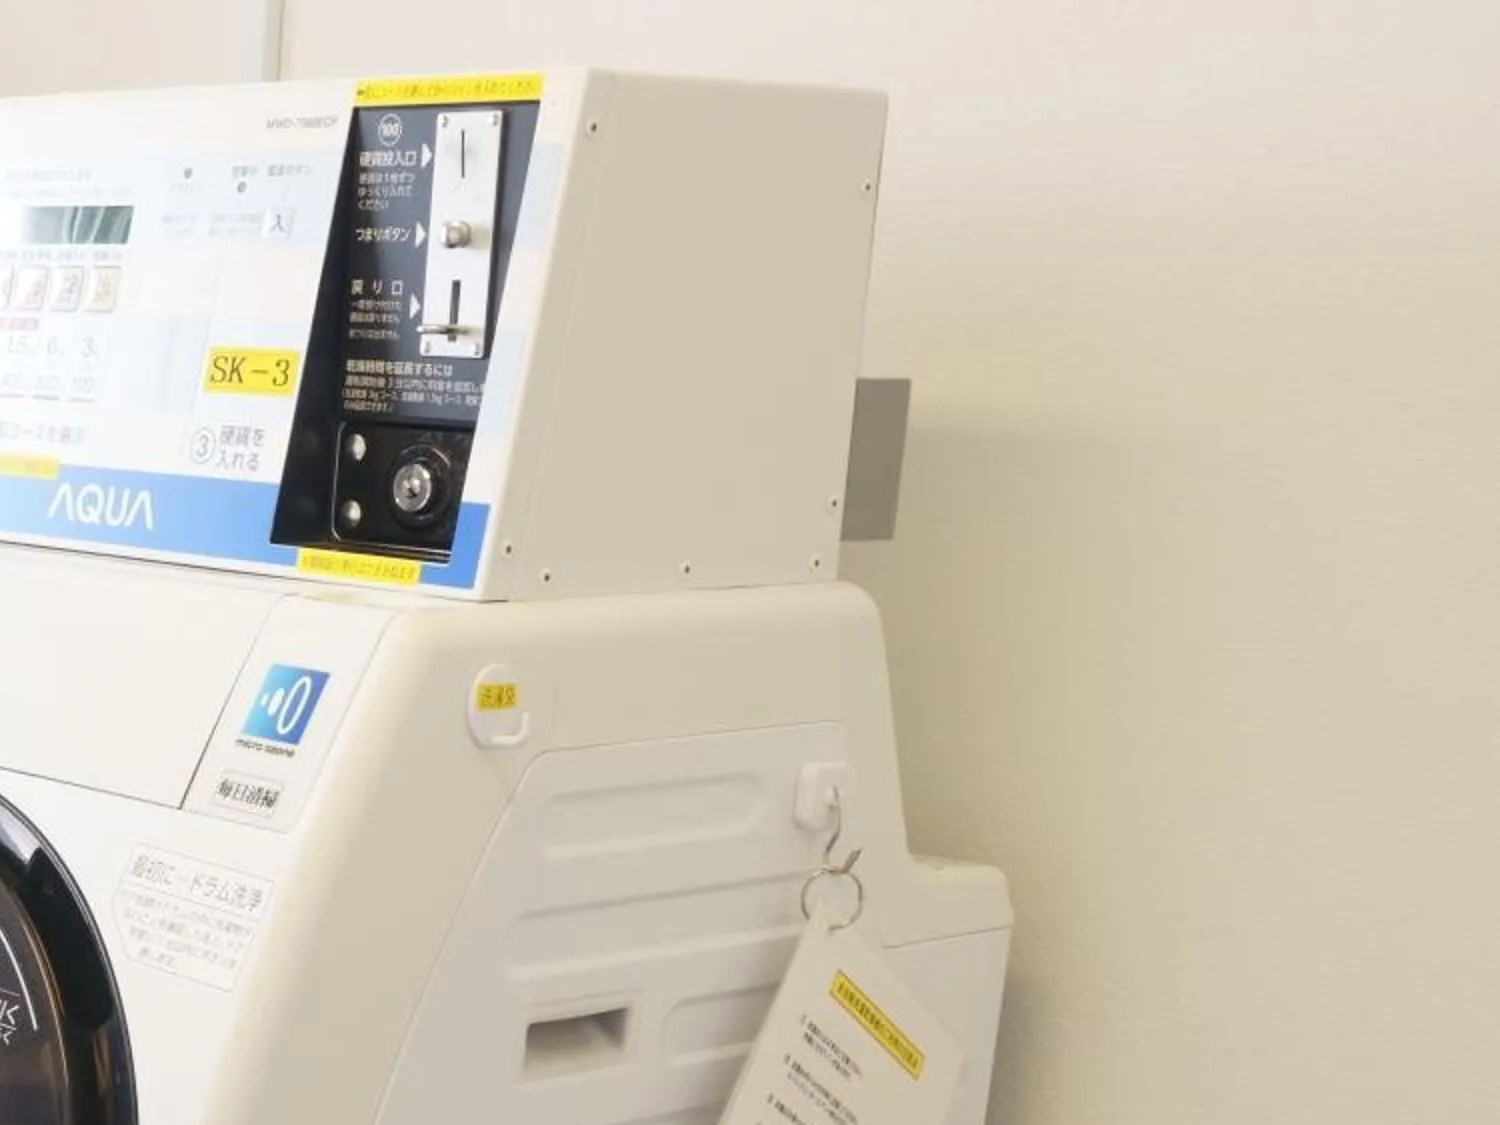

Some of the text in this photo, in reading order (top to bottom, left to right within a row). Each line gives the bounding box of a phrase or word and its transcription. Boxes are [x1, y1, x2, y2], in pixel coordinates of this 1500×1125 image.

[356, 226, 412, 242] つまりボタン
[46, 482, 154, 531] AQUA
